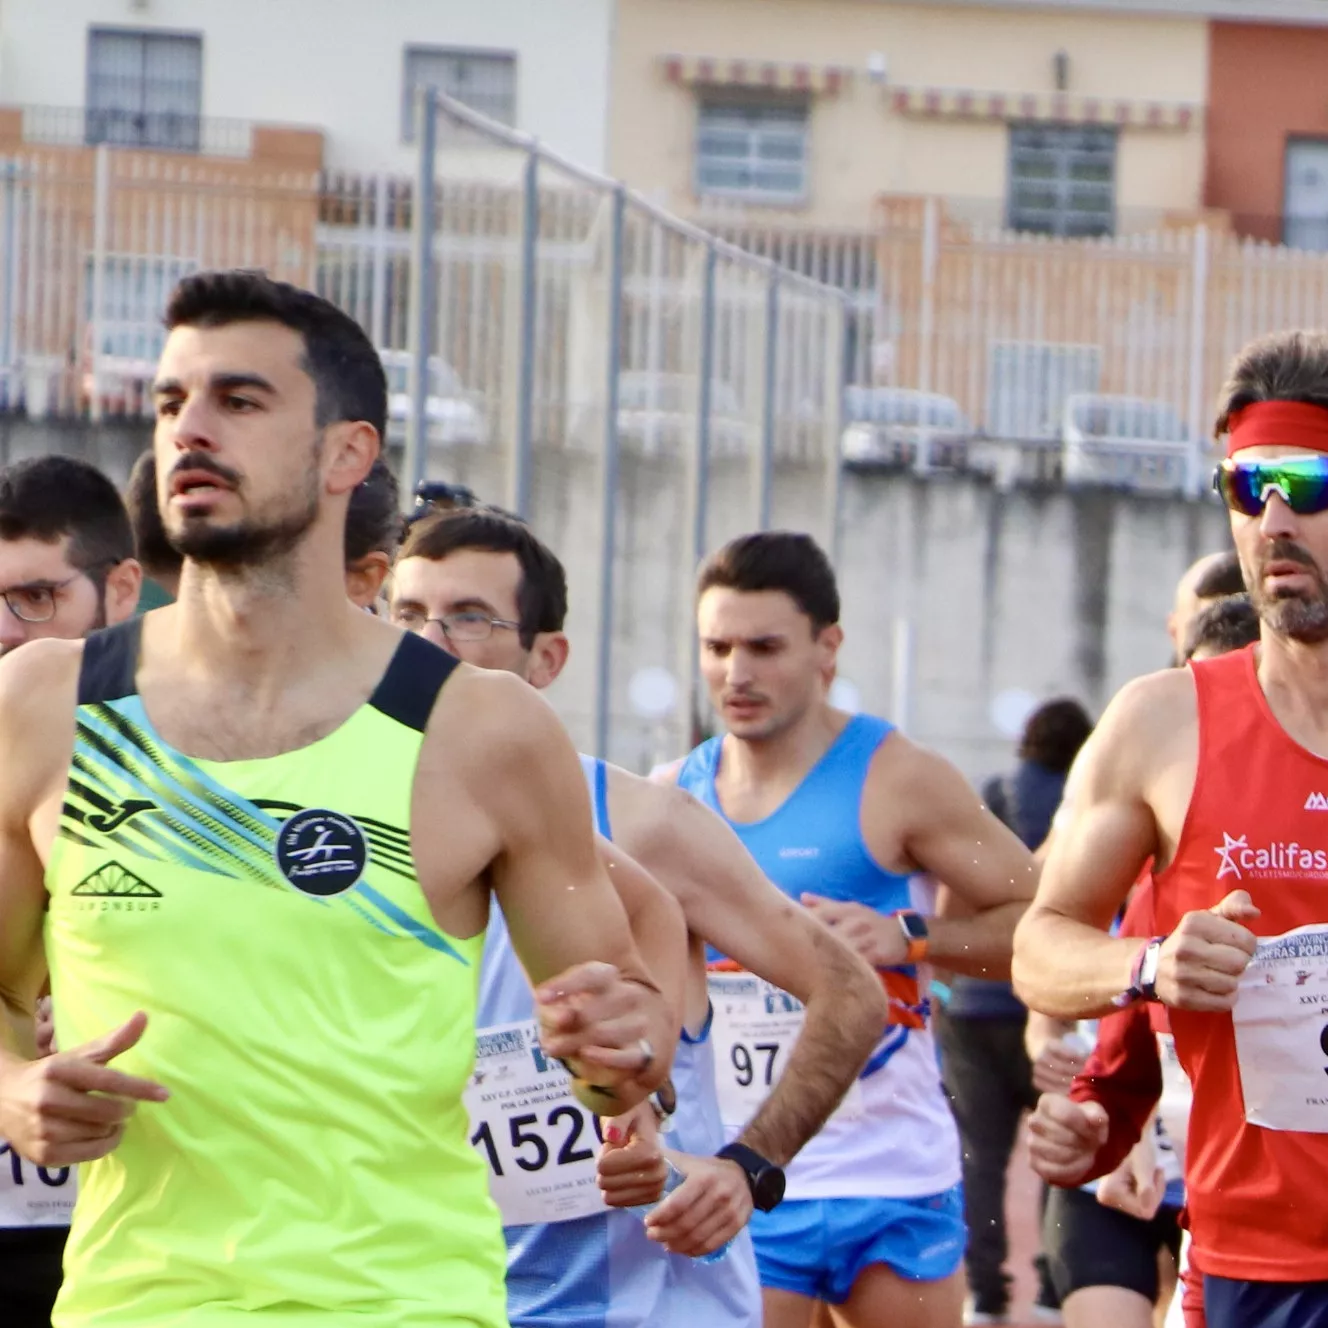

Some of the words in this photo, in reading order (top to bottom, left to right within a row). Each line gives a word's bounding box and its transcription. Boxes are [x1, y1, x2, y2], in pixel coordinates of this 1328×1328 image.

[1239, 842, 1328, 870] califas
[1299, 993, 1320, 1005] XXV
[731, 1042, 780, 1087] 97
[471, 1104, 605, 1177] 152
